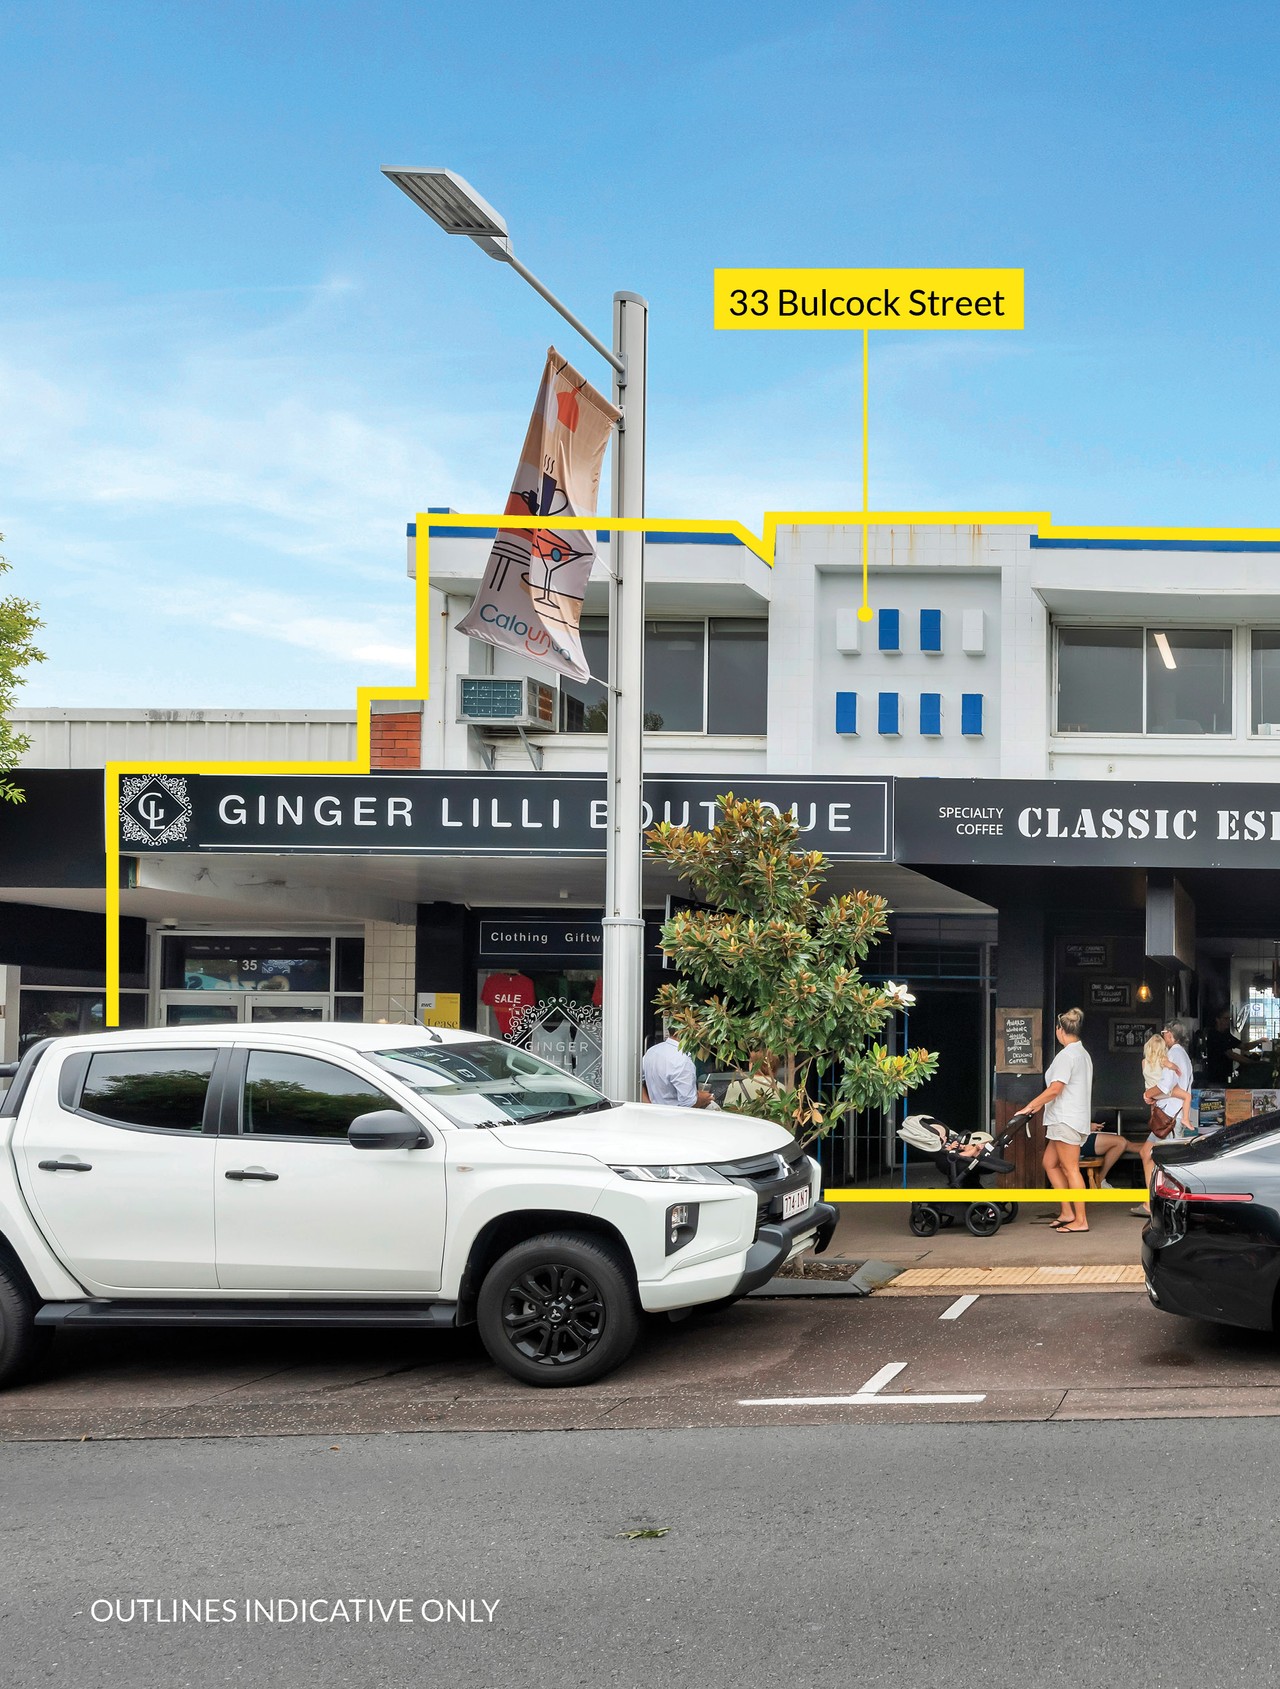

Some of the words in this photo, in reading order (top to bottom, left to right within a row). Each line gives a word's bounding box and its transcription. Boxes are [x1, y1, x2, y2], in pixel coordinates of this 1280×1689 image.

[218, 794, 413, 827] GINGER
[441, 797, 560, 829] LILLI
[939, 807, 1004, 819] SPECIALTY
[1017, 807, 1197, 839] CLASSIC
[956, 823, 1004, 836] COFFEE
[490, 932, 548, 944] Clothing
[242, 960, 258, 971] 35
[494, 993, 522, 1004] SALE
[524, 1041, 589, 1052] GINGER
